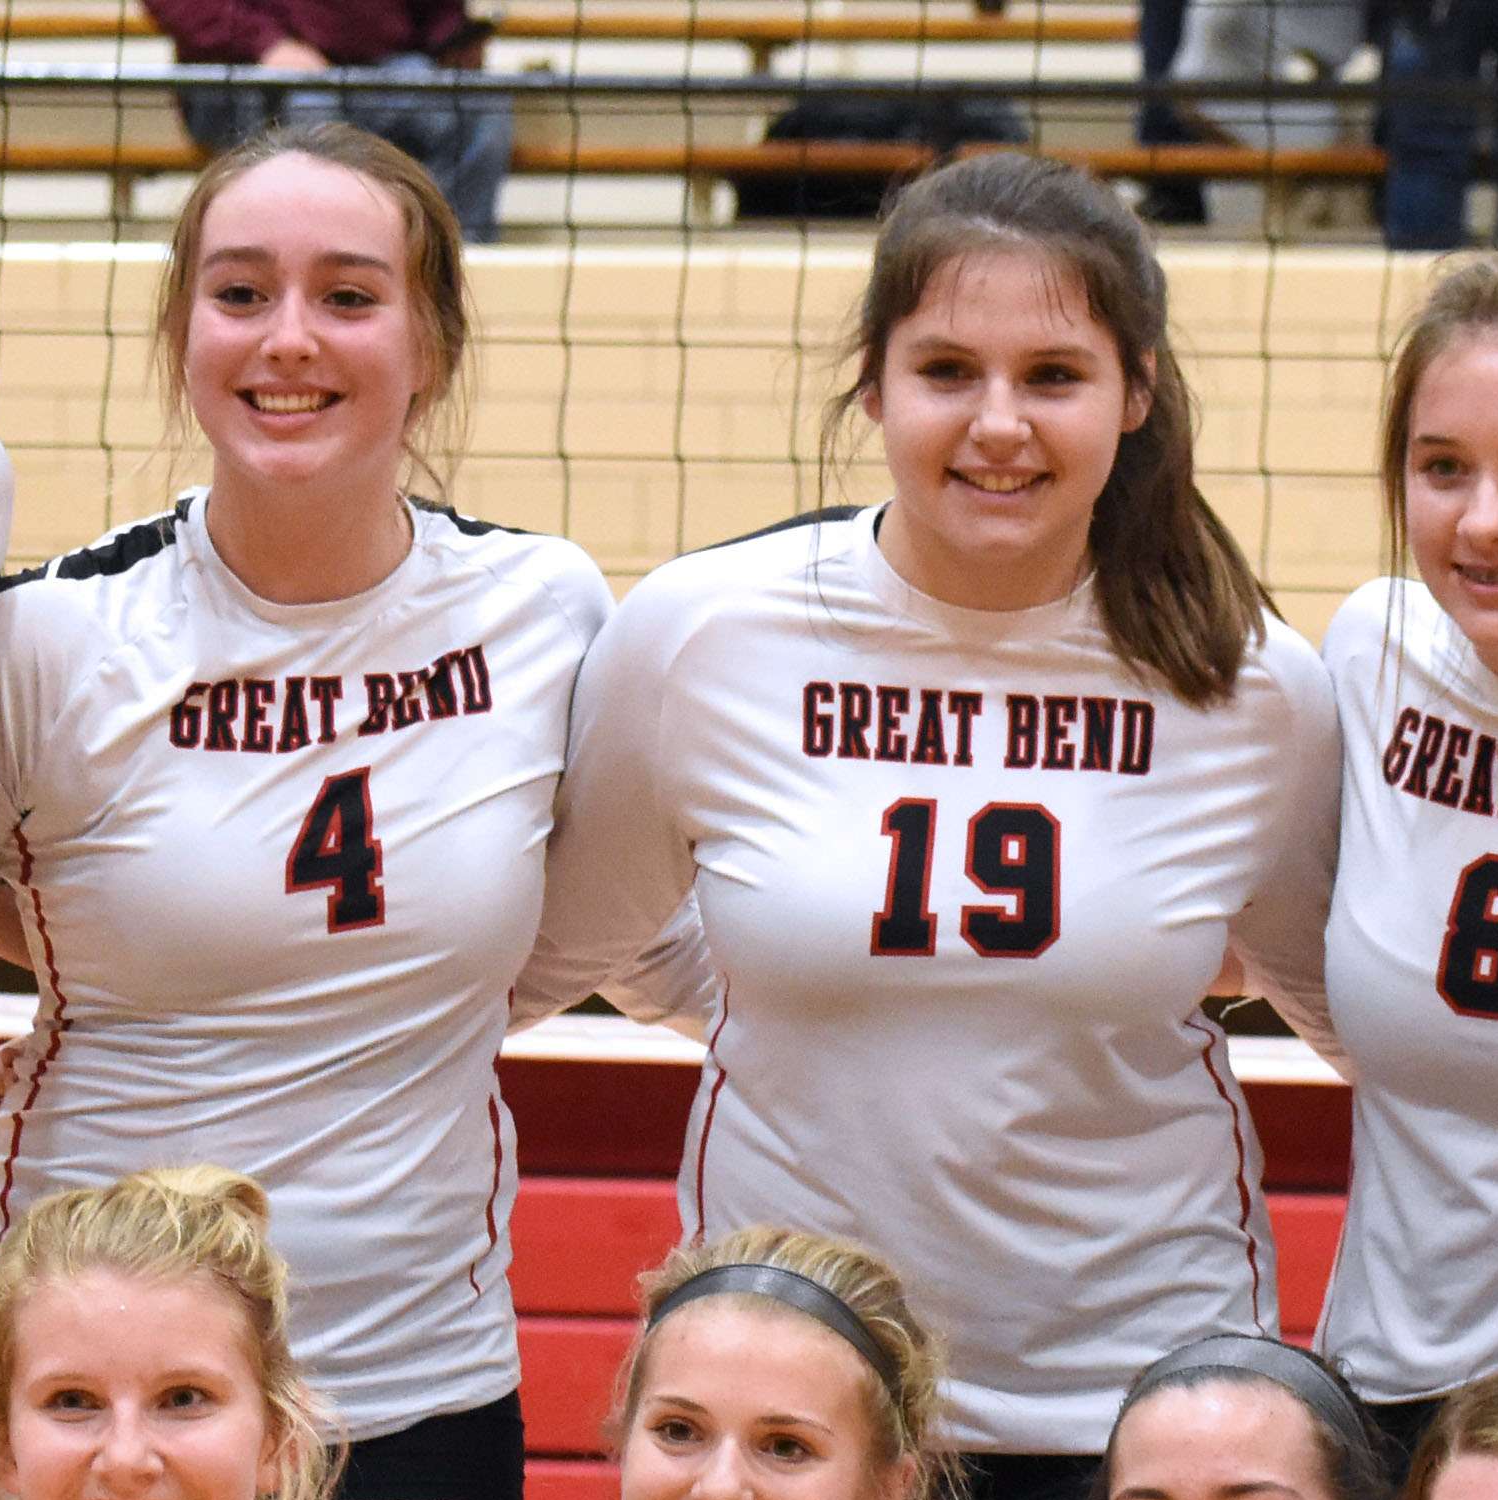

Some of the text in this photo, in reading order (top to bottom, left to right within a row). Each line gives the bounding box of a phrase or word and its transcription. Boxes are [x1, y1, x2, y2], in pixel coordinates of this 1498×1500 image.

[169, 643, 493, 754] GREAT BEND
[802, 681, 1156, 776] GREAT BEND
[285, 765, 386, 934] 4
[870, 797, 1062, 959] 19
